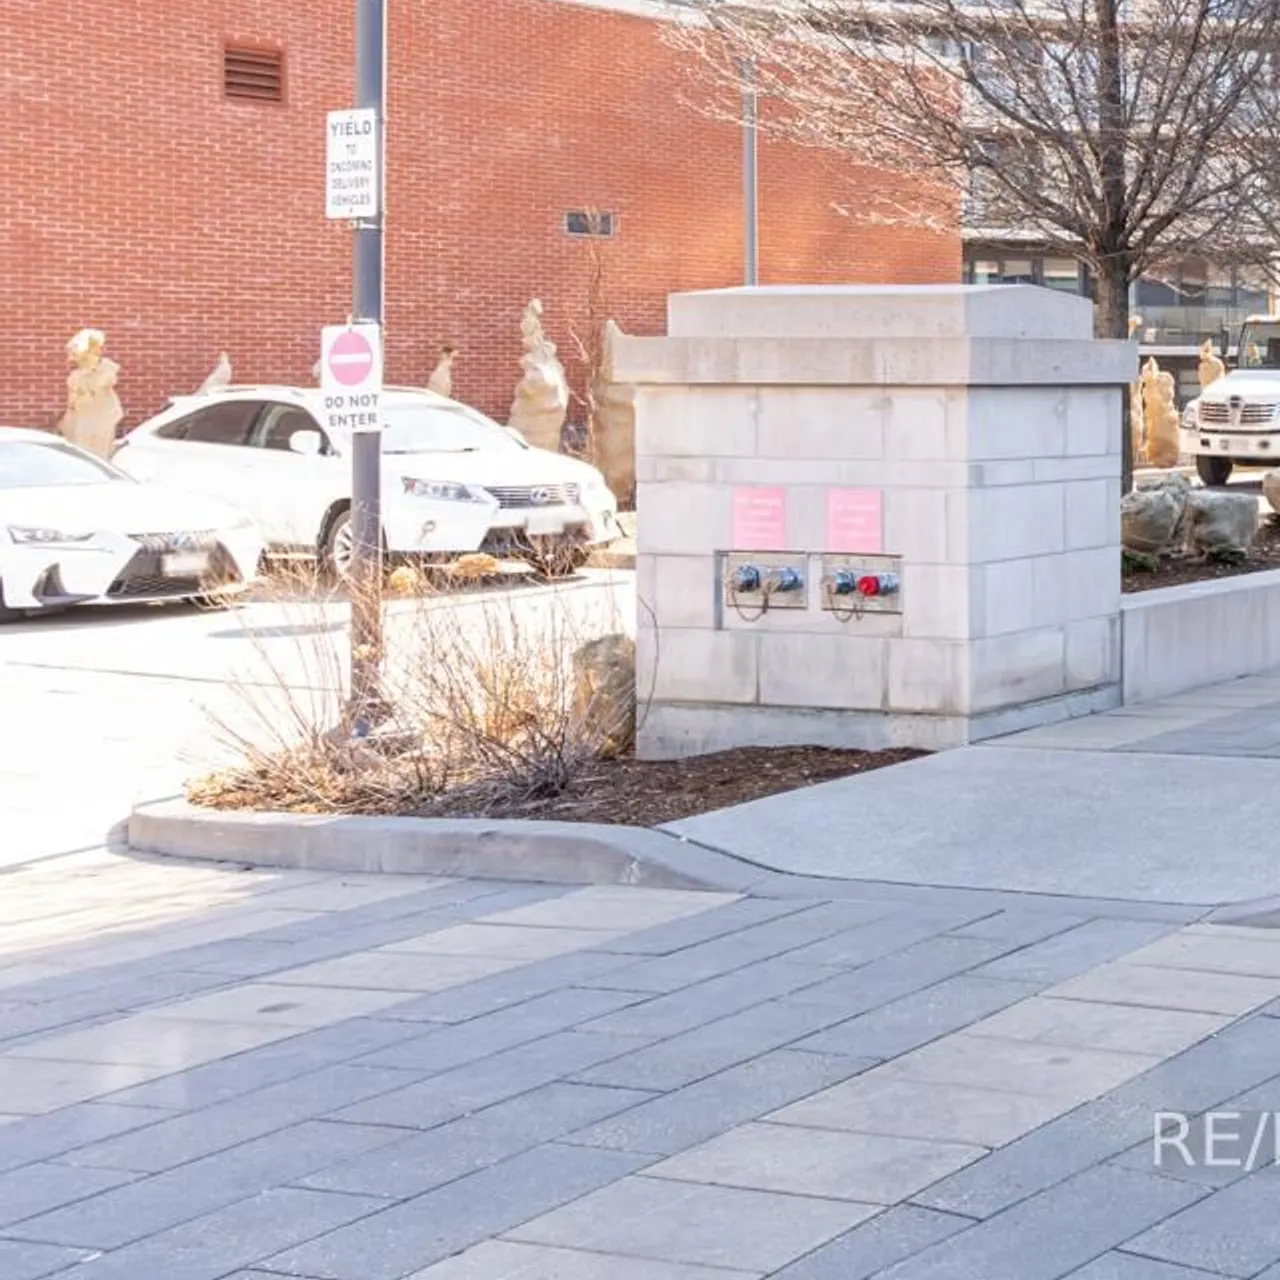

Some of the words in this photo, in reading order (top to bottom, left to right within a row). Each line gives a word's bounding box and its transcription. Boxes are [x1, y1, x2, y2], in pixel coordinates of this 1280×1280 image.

[330, 120, 372, 136] YIELD
[324, 396, 344, 409] DO
[349, 394, 379, 408] NOT
[329, 413, 377, 427] ENTER
